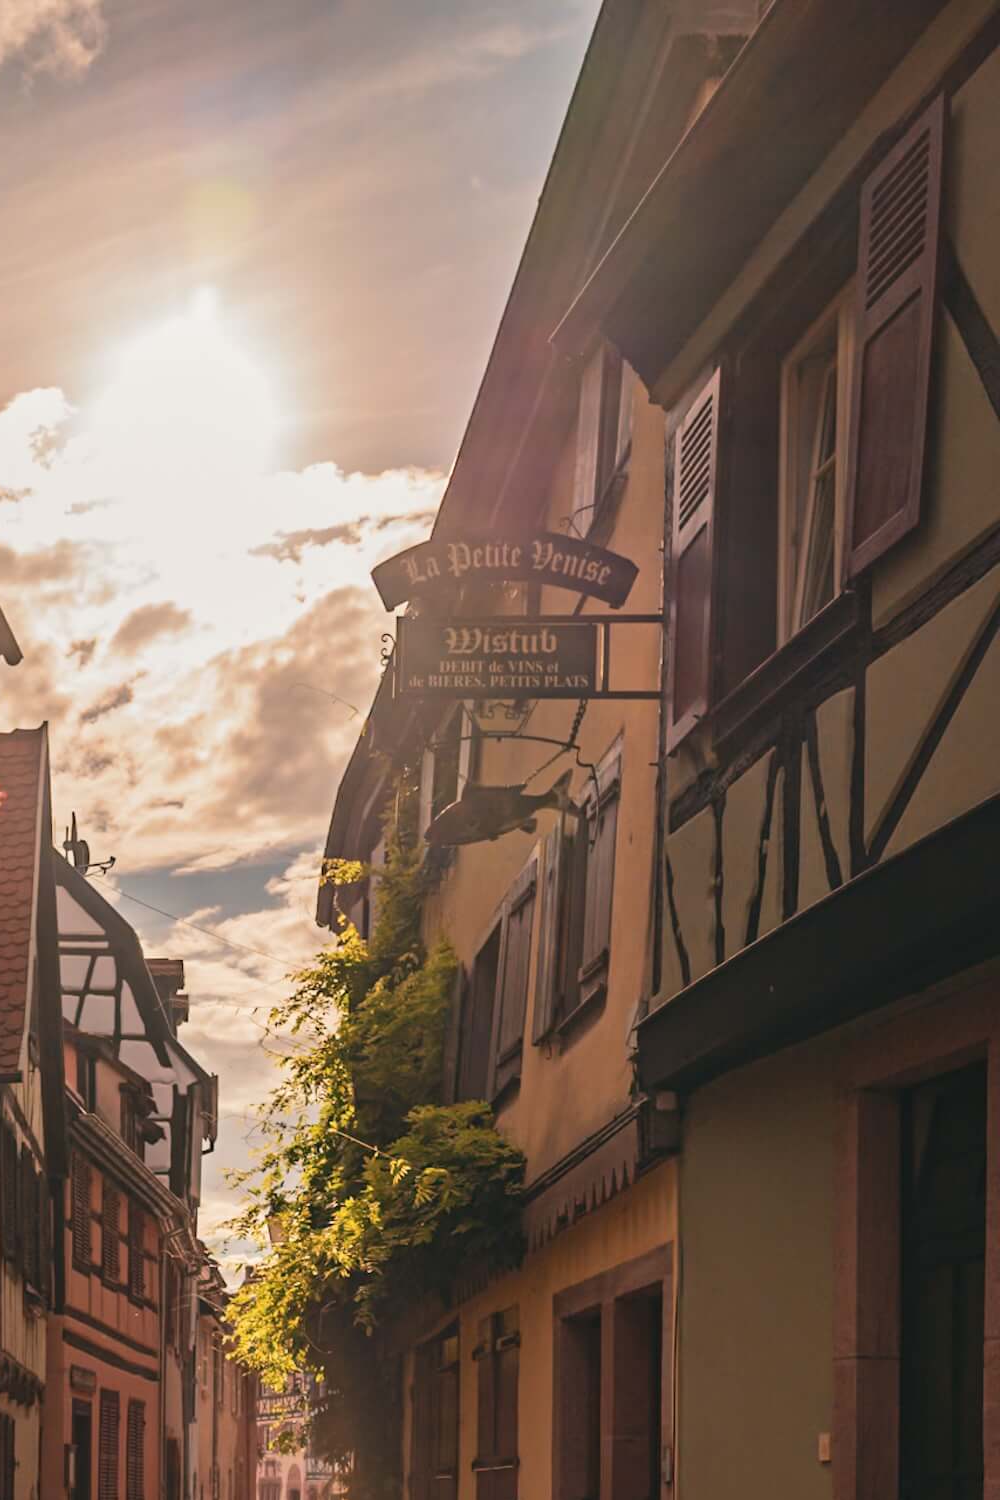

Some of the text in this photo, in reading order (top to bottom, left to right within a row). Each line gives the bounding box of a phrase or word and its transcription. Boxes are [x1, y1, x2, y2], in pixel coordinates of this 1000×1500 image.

[401, 540, 611, 585] La Petite Venise
[444, 627, 558, 654] Wistub
[489, 660, 504, 673] de
[508, 660, 543, 673] VINS
[547, 660, 559, 673] et
[409, 675, 424, 688] de
[490, 675, 540, 688] PETITS
[544, 675, 589, 688] PLATS
